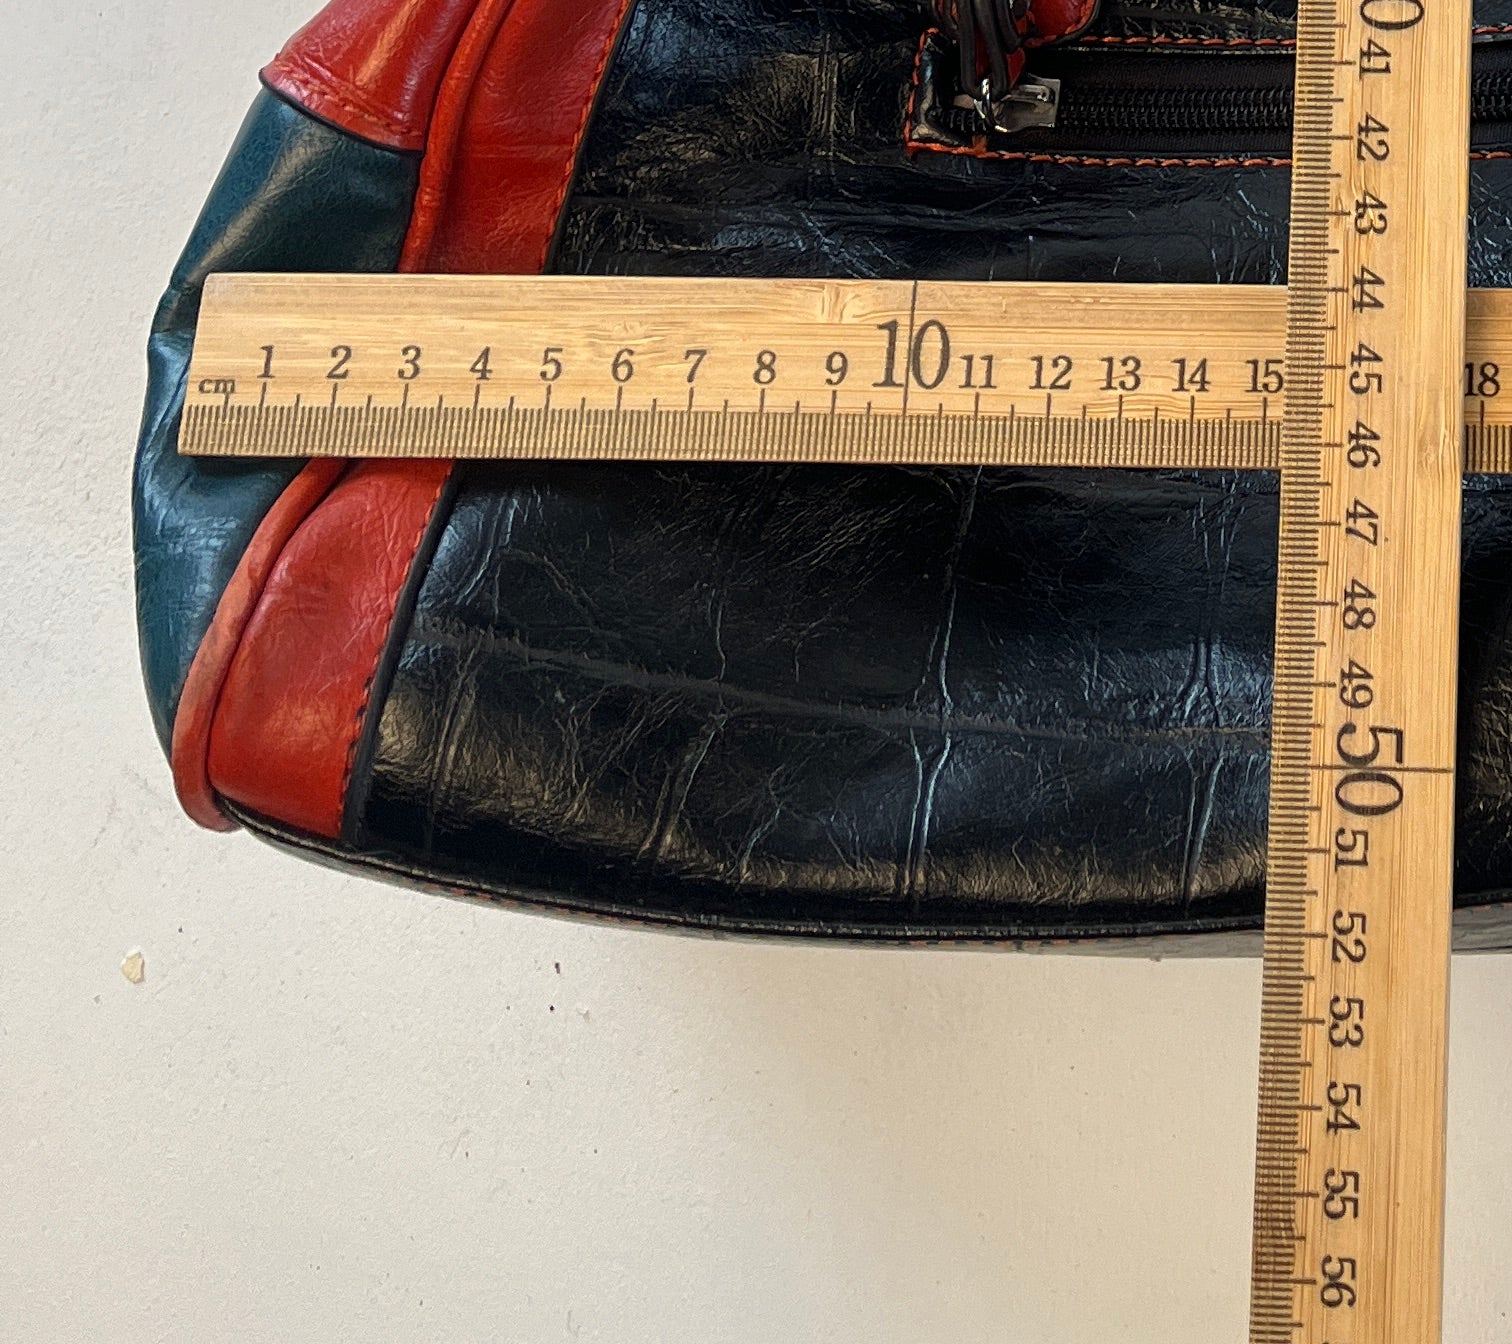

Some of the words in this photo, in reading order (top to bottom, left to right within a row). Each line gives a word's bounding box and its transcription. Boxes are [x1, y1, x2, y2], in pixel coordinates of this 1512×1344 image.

[1359, 40, 1392, 78] 41
[1356, 114, 1390, 162] 42
[1354, 190, 1388, 236] 43
[1352, 266, 1385, 313] 44
[197, 376, 236, 394] cm
[256, 345, 277, 379] 1
[327, 345, 351, 380] 2
[398, 346, 422, 380] 3
[470, 347, 493, 381] 4
[540, 348, 563, 382] 5
[610, 349, 635, 383] 6
[682, 349, 707, 383] 7
[753, 350, 777, 384] 8
[824, 351, 848, 385] 9
[872, 319, 949, 391] 10
[959, 355, 997, 389] 11
[1028, 355, 1073, 390] 12
[1098, 356, 1142, 391] 13
[1170, 358, 1211, 393] 14
[1243, 359, 1284, 394] 15
[1465, 363, 1500, 397] 18
[1349, 343, 1382, 394] 45
[1348, 420, 1381, 468] 46
[1346, 498, 1379, 546] 47
[1342, 578, 1376, 630] 48
[1340, 660, 1374, 709] 49
[1334, 724, 1404, 816] 50
[1334, 827, 1368, 870] 51
[1332, 909, 1367, 964] 52
[1328, 995, 1365, 1049] 53
[1327, 1082, 1362, 1135] 54
[1323, 1168, 1359, 1220] 55
[1320, 1255, 1357, 1308] 56
